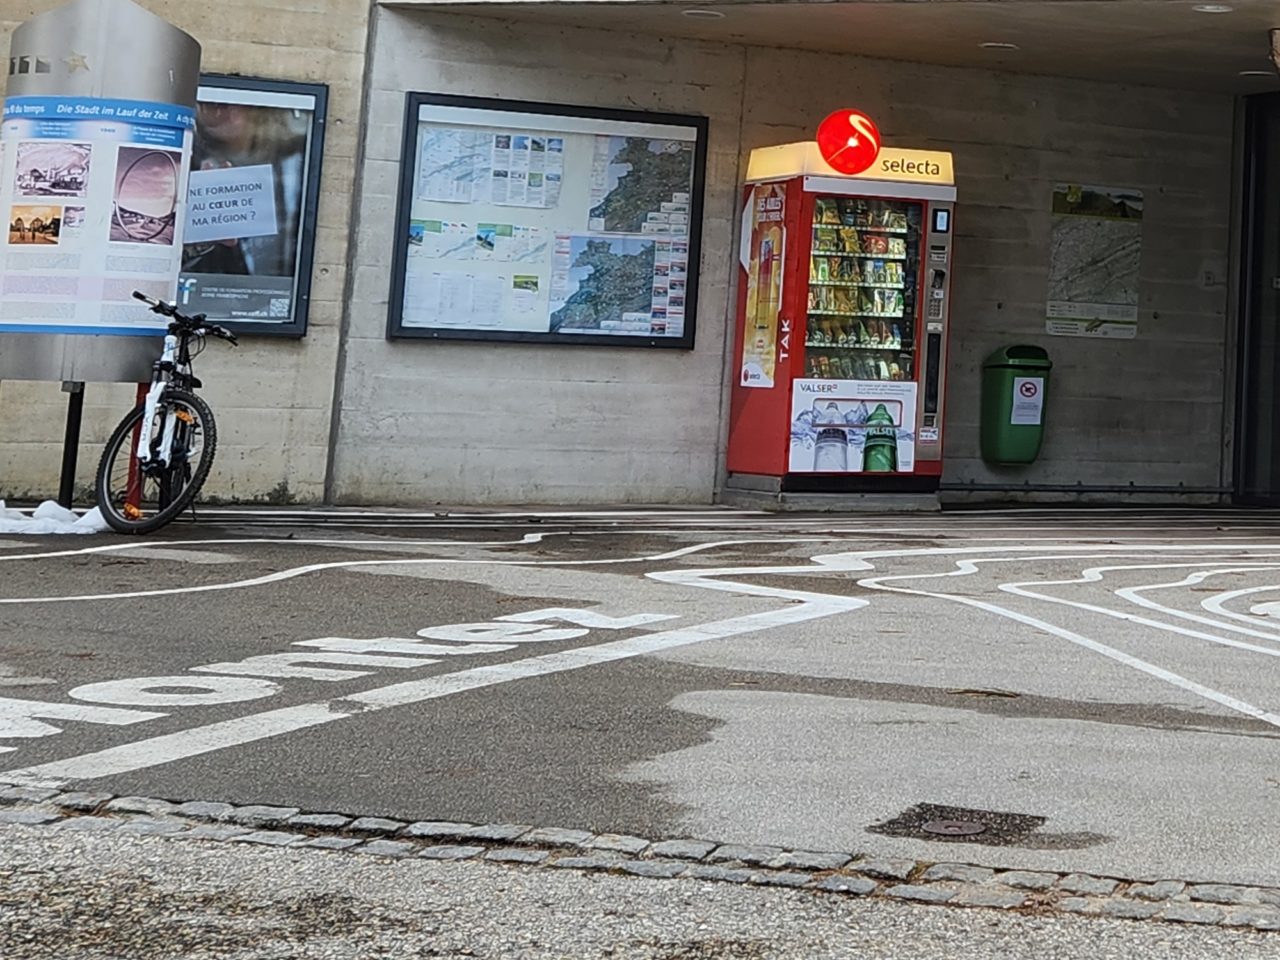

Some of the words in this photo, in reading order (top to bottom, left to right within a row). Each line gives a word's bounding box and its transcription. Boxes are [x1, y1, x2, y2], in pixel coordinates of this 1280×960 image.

[56, 105, 73, 114] Die
[74, 105, 101, 115] Stadt
[101, 107, 115, 116] im
[116, 108, 138, 117] Lauf
[138, 110, 153, 119] der
[153, 111, 169, 120] Zeit
[881, 158, 940, 176] selecta
[205, 183, 262, 195] FORMATION
[192, 203, 206, 212] AU
[209, 200, 239, 210] CŒUR
[241, 198, 254, 207] DE
[192, 218, 209, 227] MA
[211, 214, 248, 224] RÉGION
[800, 383, 833, 393] VALSER
